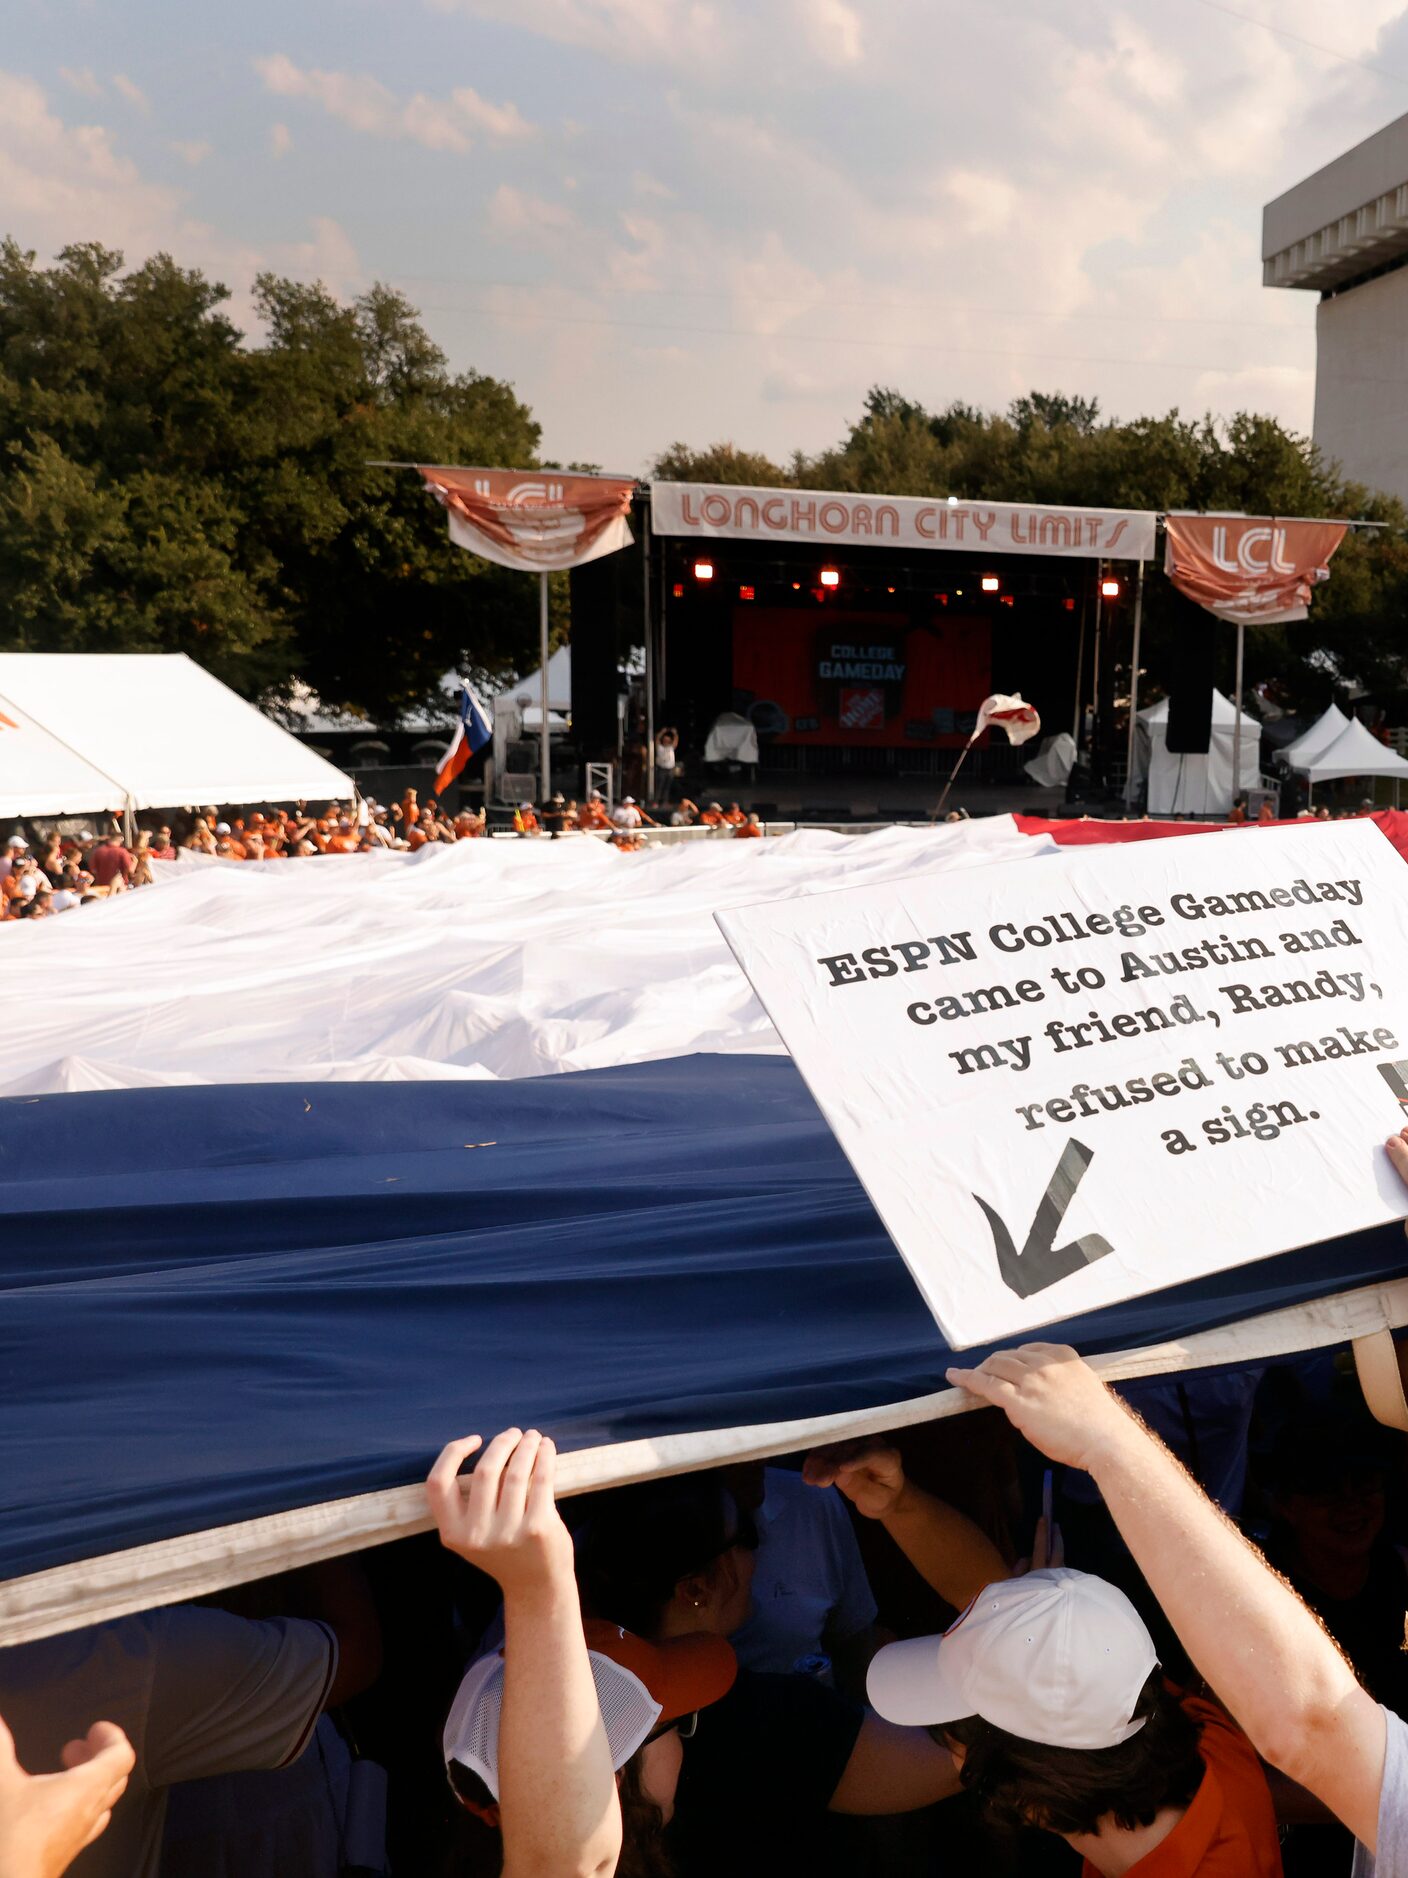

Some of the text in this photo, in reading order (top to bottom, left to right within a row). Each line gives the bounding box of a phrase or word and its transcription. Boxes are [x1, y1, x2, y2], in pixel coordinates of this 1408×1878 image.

[681, 493, 1129, 549] LONGHORN CITY LIMITS
[1212, 526, 1296, 574] LCL
[819, 661, 906, 680] GAMEDAY
[817, 879, 1364, 987] ESPN College Gameday
[906, 919, 1363, 1025] came to Austin and
[948, 964, 1384, 1075] my friend, Randy,
[1015, 1026, 1399, 1131] refused to make
[1159, 1099, 1321, 1155] a sign.
